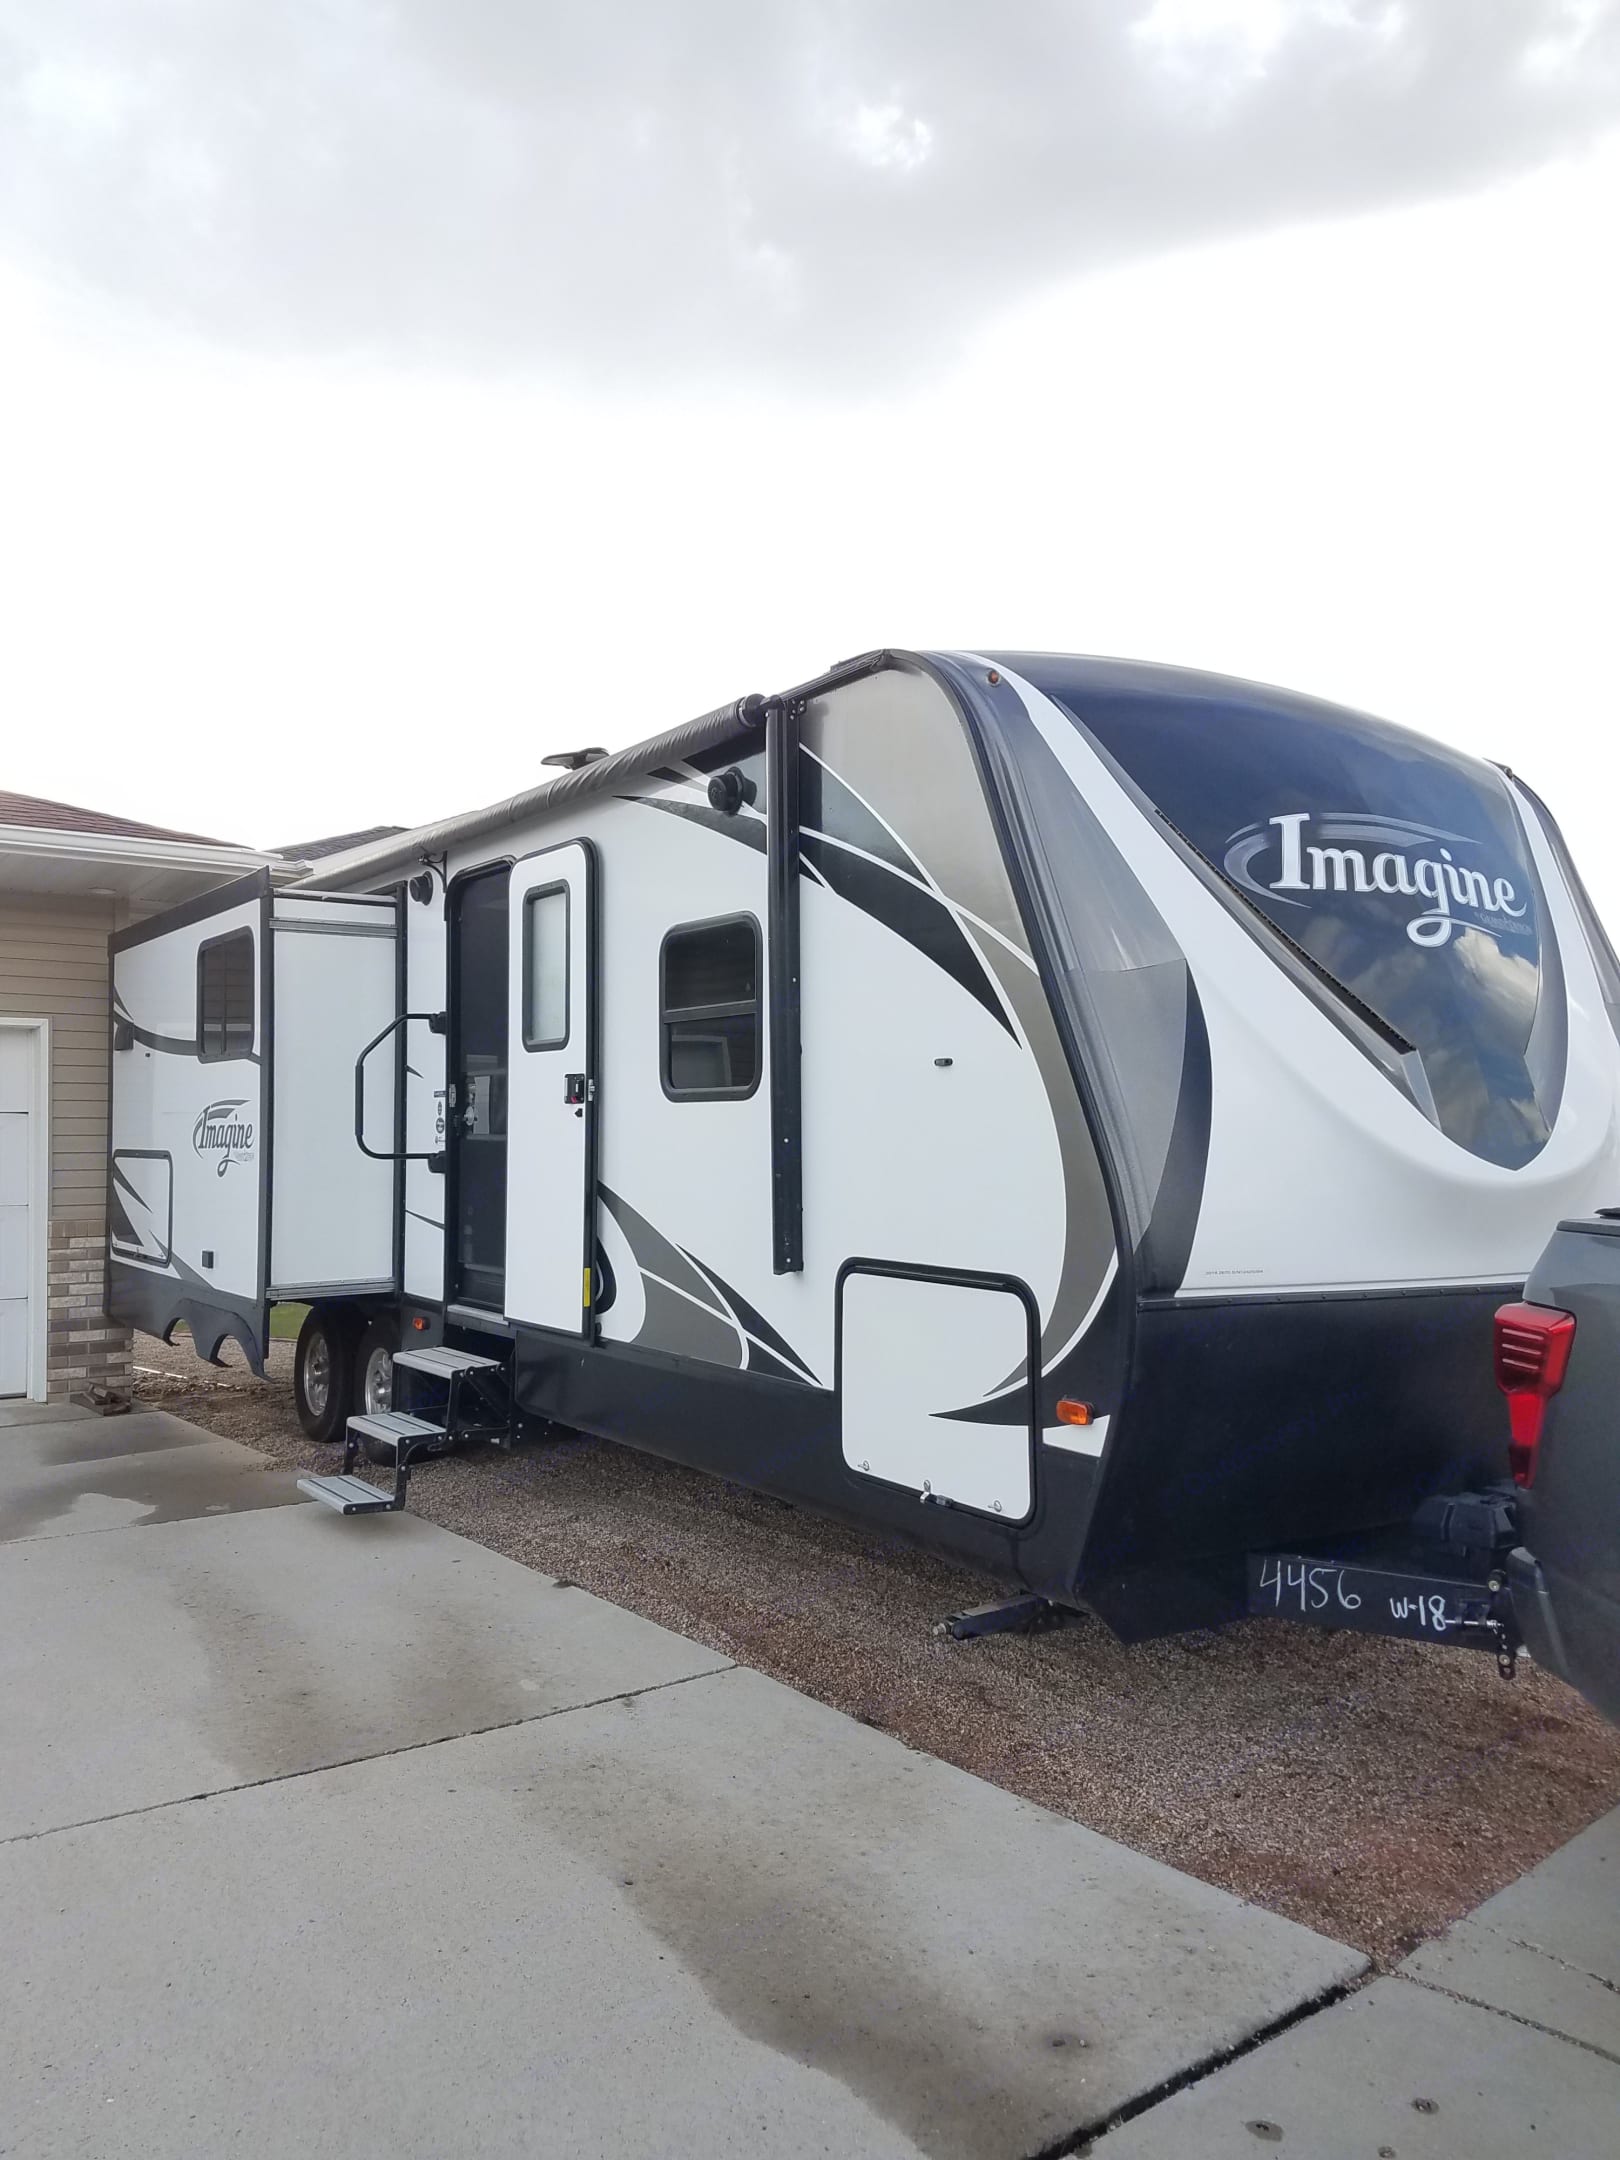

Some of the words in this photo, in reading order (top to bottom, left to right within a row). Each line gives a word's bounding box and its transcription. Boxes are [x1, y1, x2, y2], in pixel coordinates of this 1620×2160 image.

[1268, 812, 1528, 948] Imagine
[197, 1103, 255, 1178] Imagine
[1260, 1558, 1362, 1612] 4456
